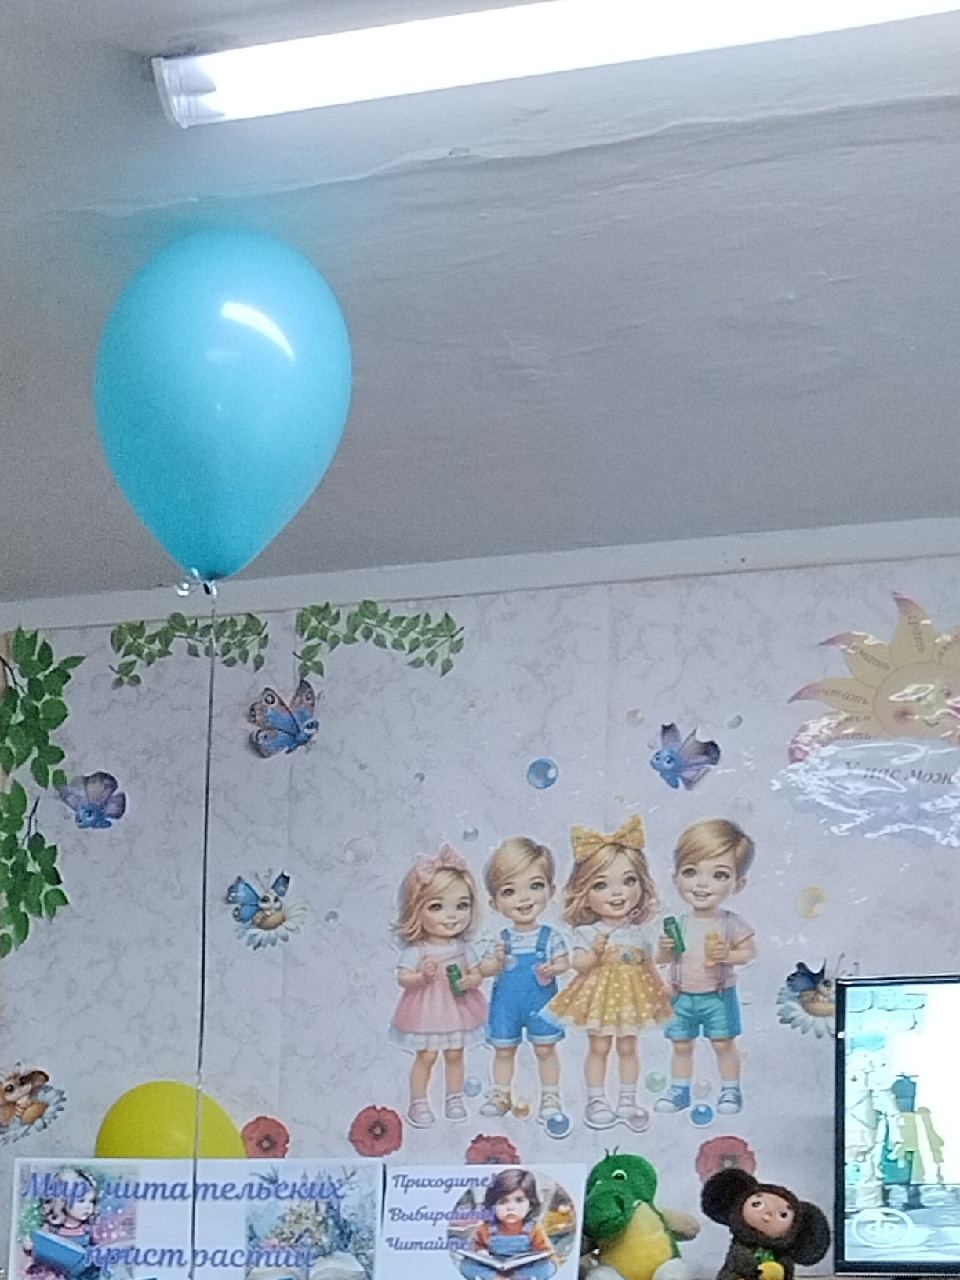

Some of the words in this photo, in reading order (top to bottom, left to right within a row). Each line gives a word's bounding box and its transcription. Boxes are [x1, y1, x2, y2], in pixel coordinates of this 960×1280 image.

[22, 1171, 90, 1210] Мир
[103, 1179, 346, 1201] читательских
[391, 1173, 497, 1194] Приходите!
